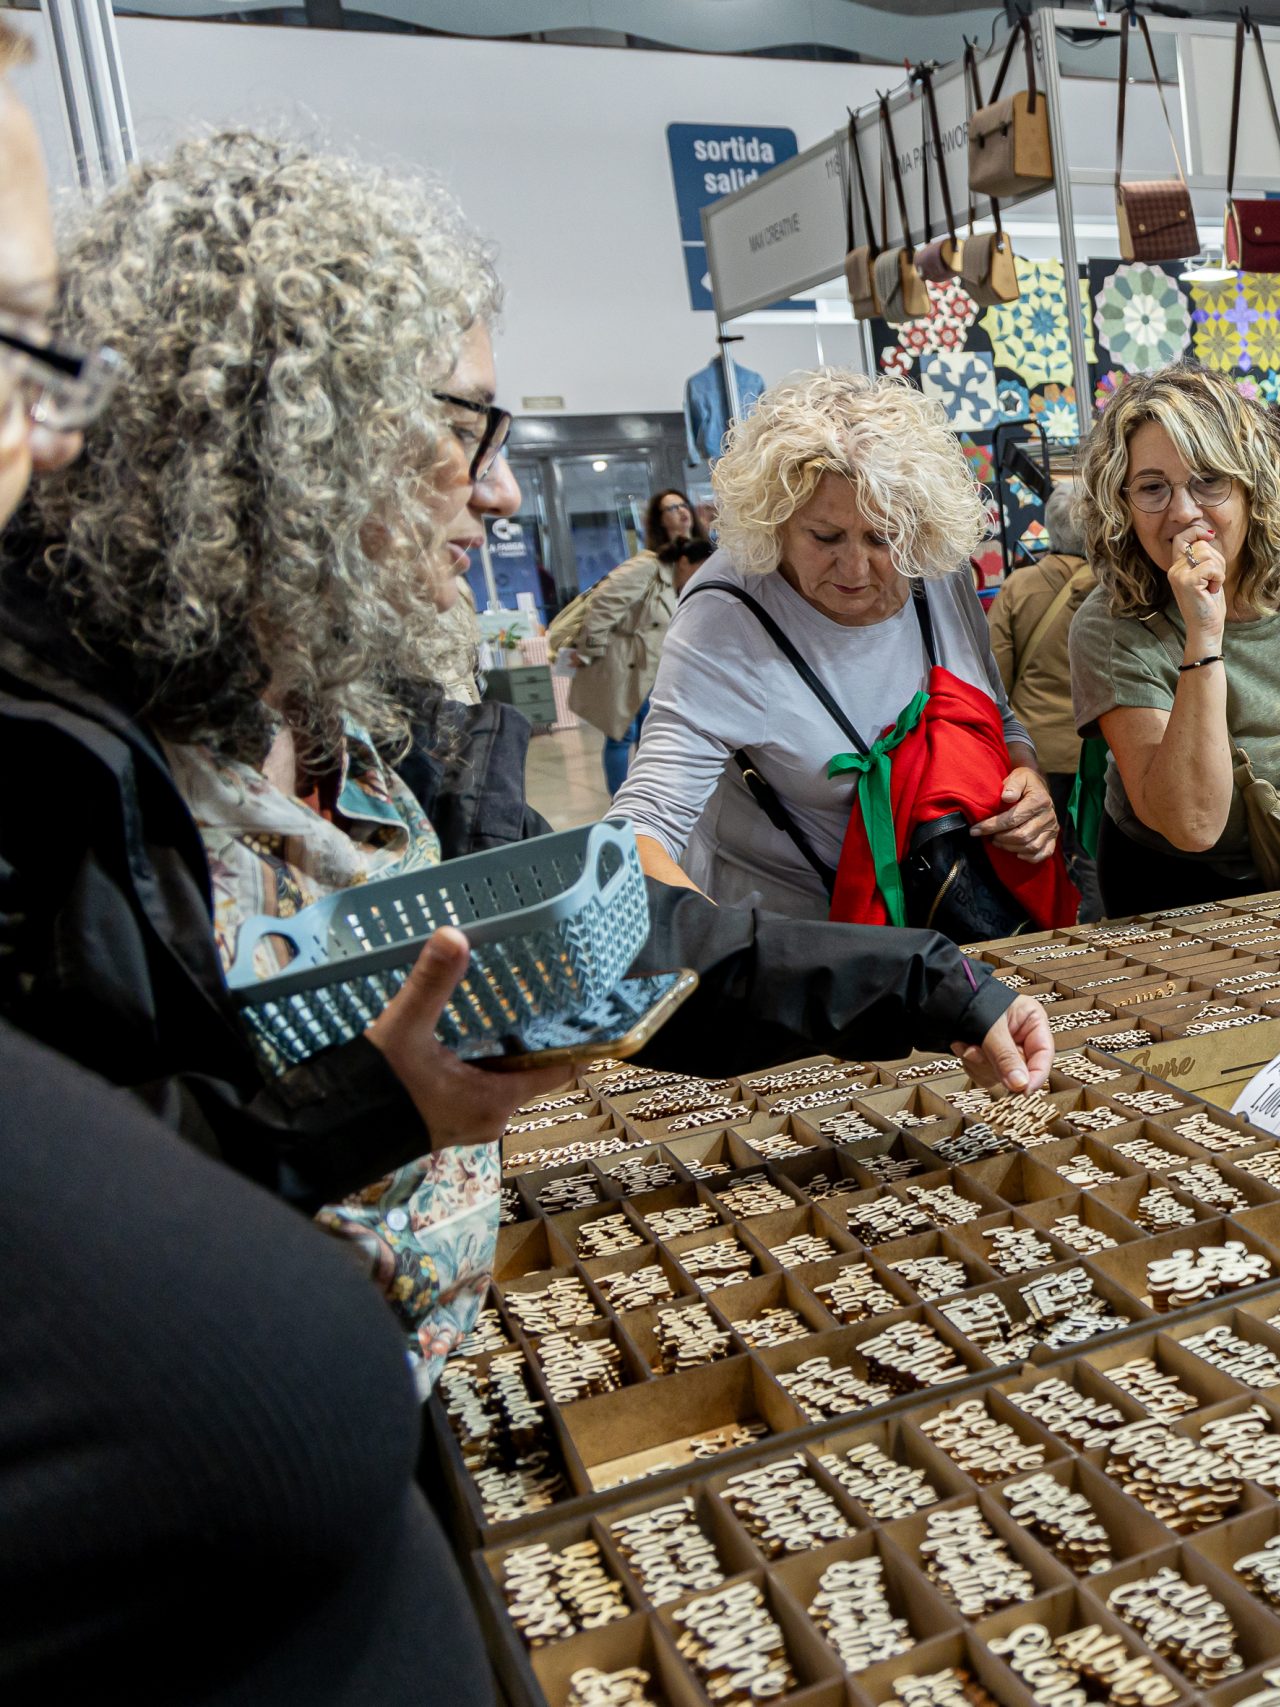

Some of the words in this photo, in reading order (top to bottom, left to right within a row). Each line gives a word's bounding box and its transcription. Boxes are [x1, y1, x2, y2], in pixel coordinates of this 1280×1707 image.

[693, 136, 775, 164] sortida
[703, 168, 759, 194] salid
[1055, 1626, 1174, 1704] Aloha
